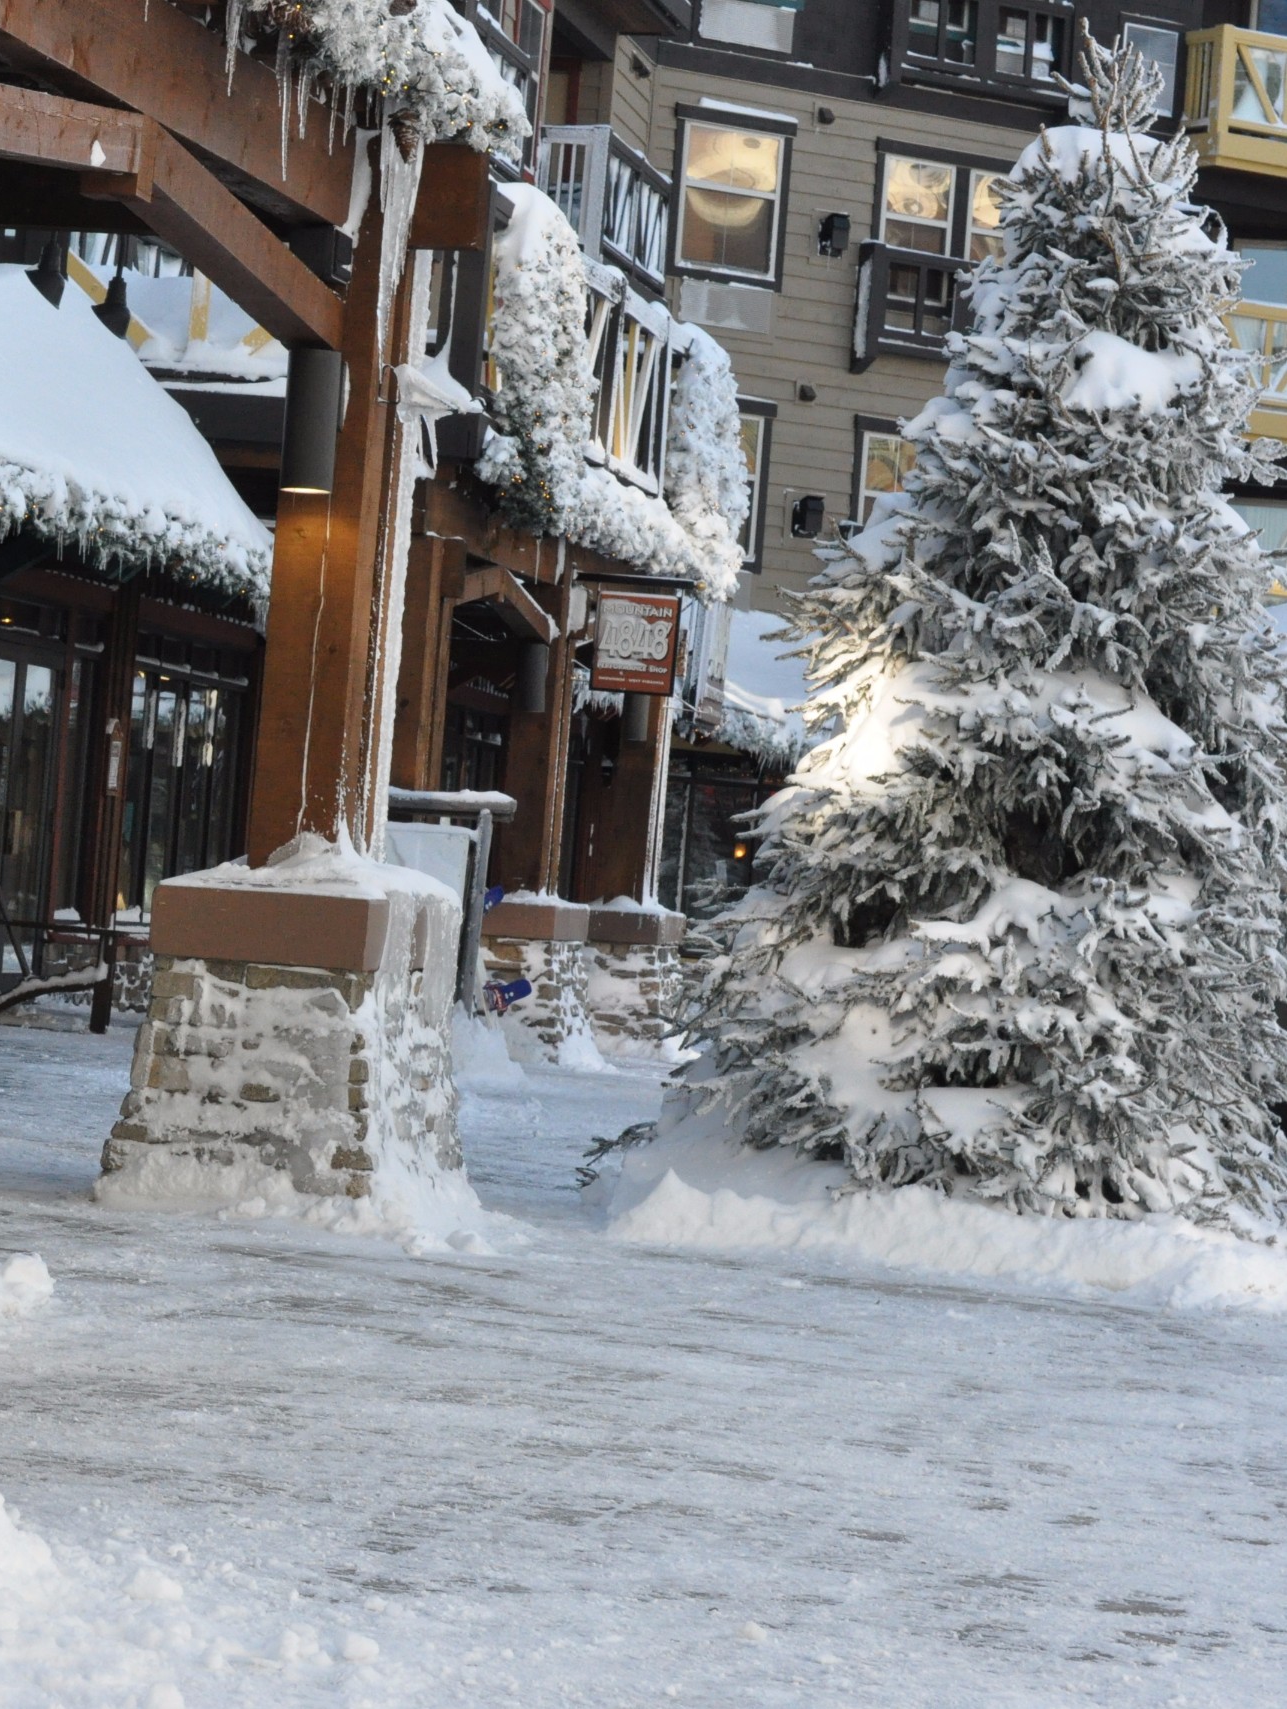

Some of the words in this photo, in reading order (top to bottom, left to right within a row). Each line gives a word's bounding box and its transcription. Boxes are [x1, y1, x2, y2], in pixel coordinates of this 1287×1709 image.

[602, 602, 673, 618] MOUNTAIN
[598, 619, 674, 661] 4848
[649, 664, 668, 674] SHOP
